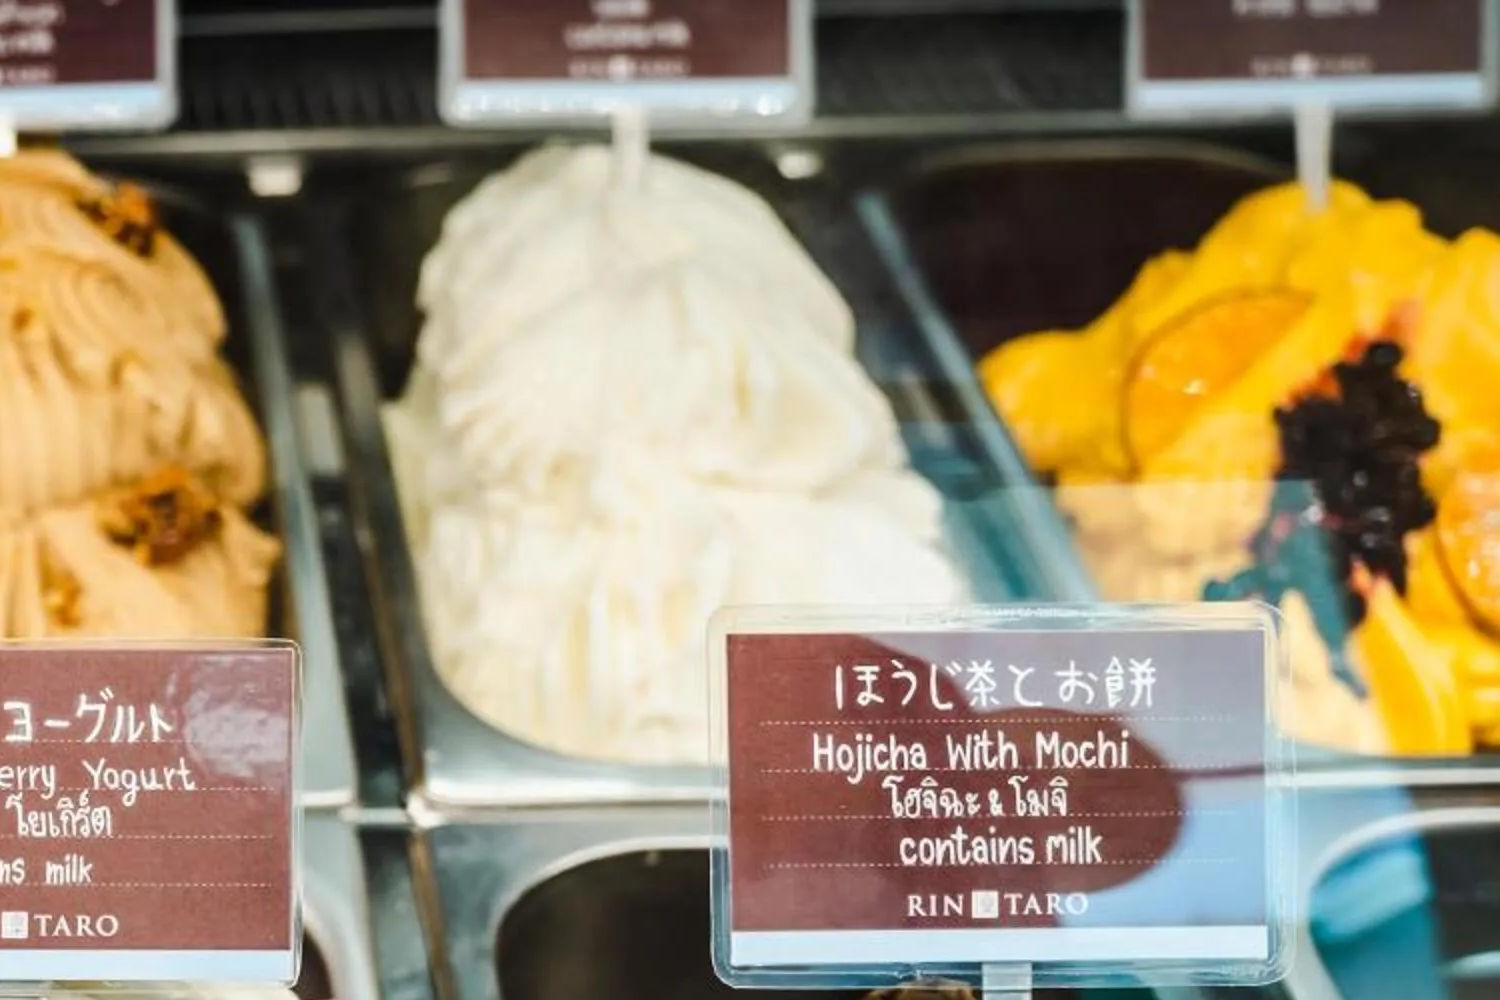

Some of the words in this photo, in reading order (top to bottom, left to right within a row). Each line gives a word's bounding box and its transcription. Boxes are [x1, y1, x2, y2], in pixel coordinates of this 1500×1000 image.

[813, 732, 928, 784] Hojicha
[1036, 730, 1130, 768] Mochi
[82, 757, 196, 807] Yogurt
[900, 827, 1035, 866] contains
[1046, 827, 1102, 865] milk
[46, 854, 93, 885] milk
[907, 894, 963, 916] RIN
[1004, 893, 1088, 915] TARO
[33, 914, 119, 938] TARO
